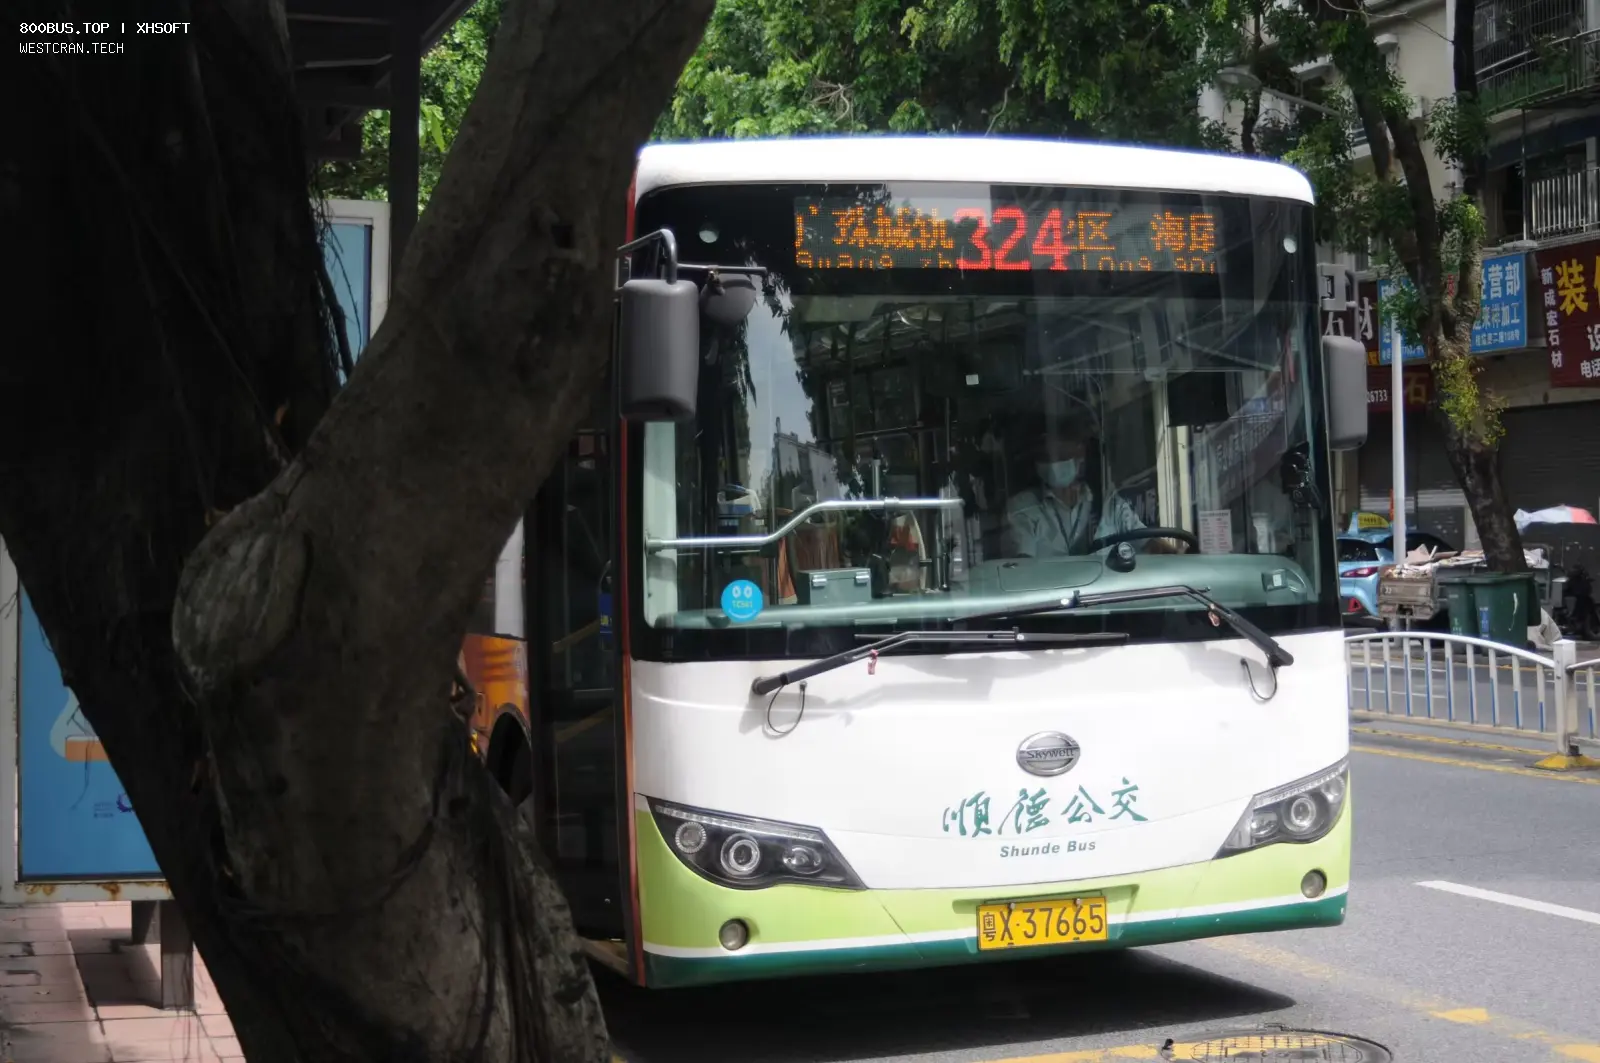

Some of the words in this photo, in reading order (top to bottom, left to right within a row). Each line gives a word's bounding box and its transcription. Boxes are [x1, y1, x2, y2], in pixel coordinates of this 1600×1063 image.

[952, 207, 1069, 272] 324
[999, 842, 1061, 858] Shunde
[1067, 839, 1096, 853] Bus
